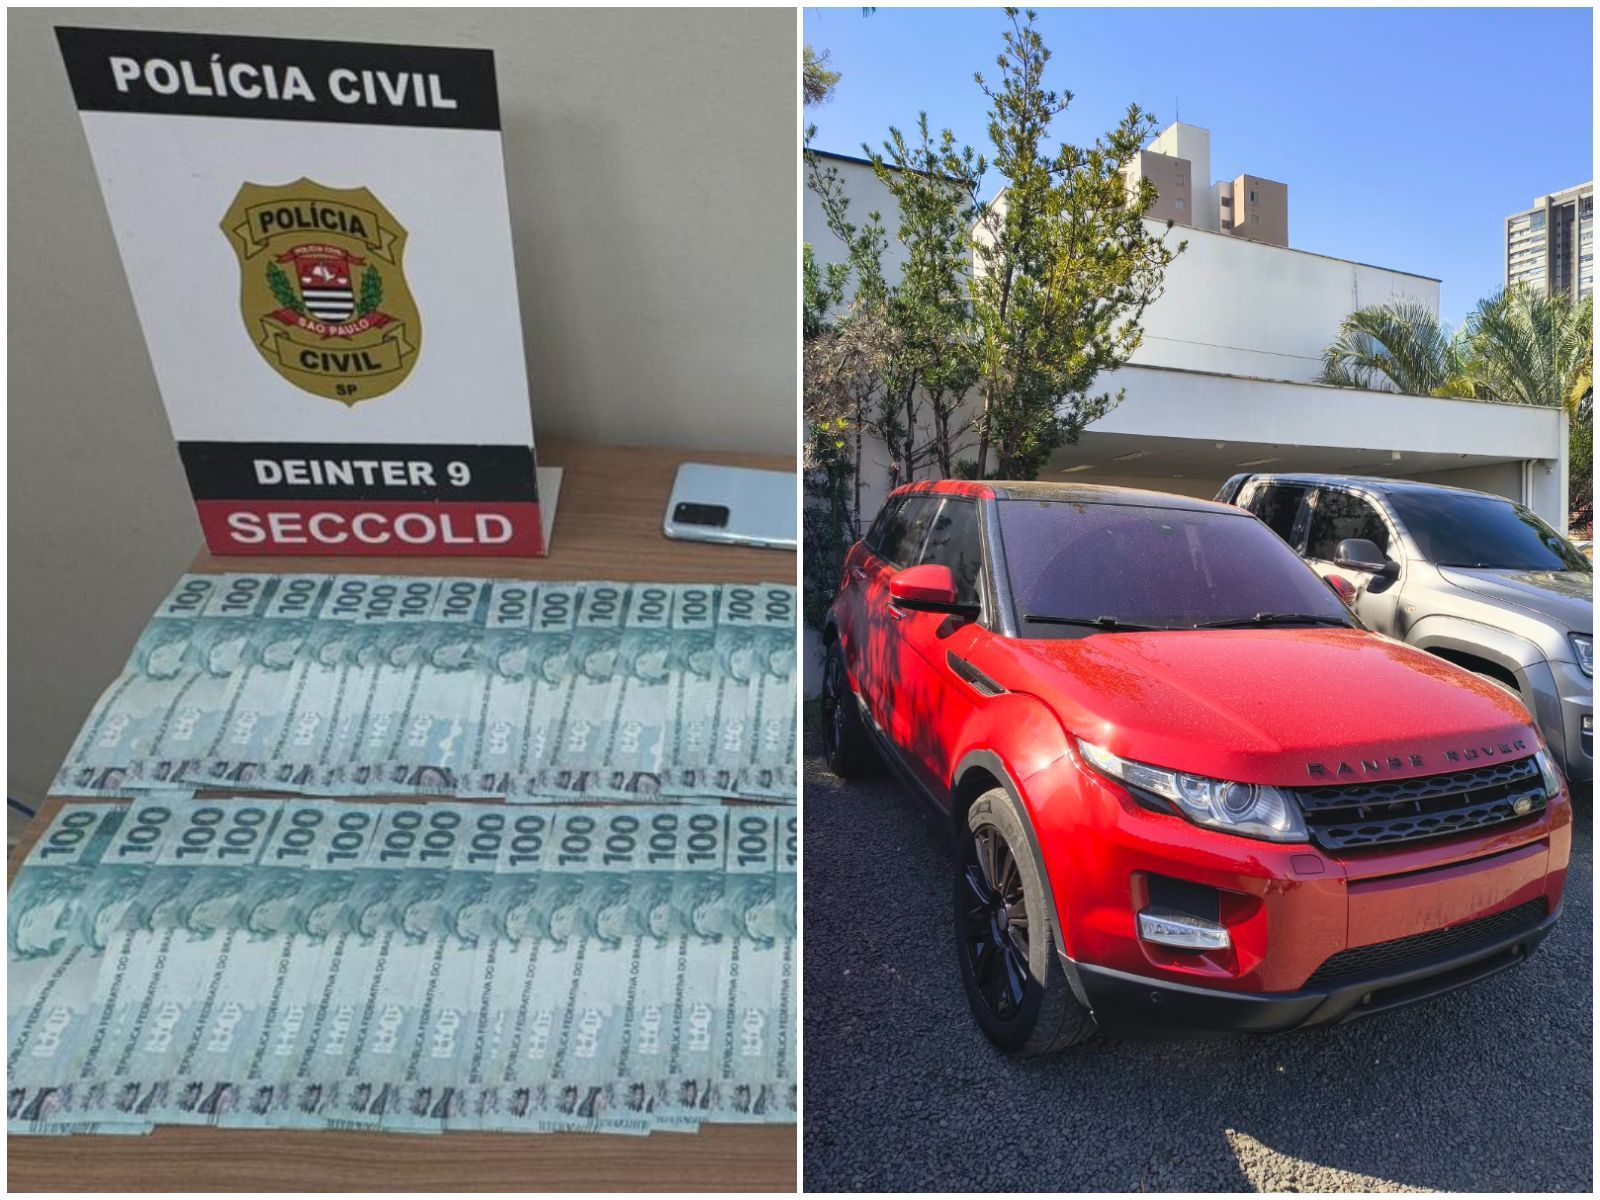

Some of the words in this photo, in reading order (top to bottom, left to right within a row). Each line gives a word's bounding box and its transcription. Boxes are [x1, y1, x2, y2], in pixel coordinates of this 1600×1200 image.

[109, 53, 316, 102] POLÍCIA
[329, 69, 457, 109] CIVIL
[259, 202, 367, 238] POLÍCIA
[329, 320, 370, 336] PAULO
[300, 350, 382, 372] CIVIL
[336, 385, 358, 396] SP
[253, 459, 436, 487] DEINTER
[449, 461, 471, 487] 9
[227, 512, 514, 545] SECCOLD
[169, 580, 212, 613] 100
[221, 577, 261, 613] 100
[278, 578, 316, 613] 100
[333, 580, 367, 615] 100
[365, 585, 397, 619] 100
[399, 582, 432, 617] 100
[443, 581, 476, 617] 100
[498, 588, 527, 624] 100
[541, 592, 570, 628] 100
[588, 587, 619, 623] 100
[637, 588, 666, 624] 100
[682, 589, 709, 625] 100
[729, 588, 756, 623] 100
[766, 589, 791, 623] 100
[1306, 755, 1424, 777] RANGE
[1445, 740, 1527, 761] ROVER
[41, 811, 98, 859] 100
[119, 806, 172, 857] 100
[176, 807, 225, 858] 100
[218, 808, 267, 858] 100
[277, 808, 324, 860] 100
[327, 811, 371, 863] 100
[380, 810, 423, 862] 100
[420, 811, 461, 861] 100
[468, 813, 505, 864] 100
[509, 815, 545, 867] 100
[558, 815, 596, 866] 100
[603, 815, 640, 865] 100
[649, 813, 678, 864] 100
[687, 814, 718, 865] 100
[737, 816, 768, 867] 100
[116, 955, 128, 971] DO
[154, 955, 166, 970] DO
[216, 953, 228, 970] DO
[278, 959, 289, 973] DO
[329, 957, 341, 973] DO
[375, 957, 387, 973] DO
[430, 961, 441, 977] DO
[484, 965, 494, 980] DO
[525, 963, 536, 978] DO
[572, 961, 583, 977] DO
[630, 959, 640, 974] DO
[677, 957, 686, 972] DO
[729, 962, 738, 977] DO
[782, 962, 791, 977] DO
